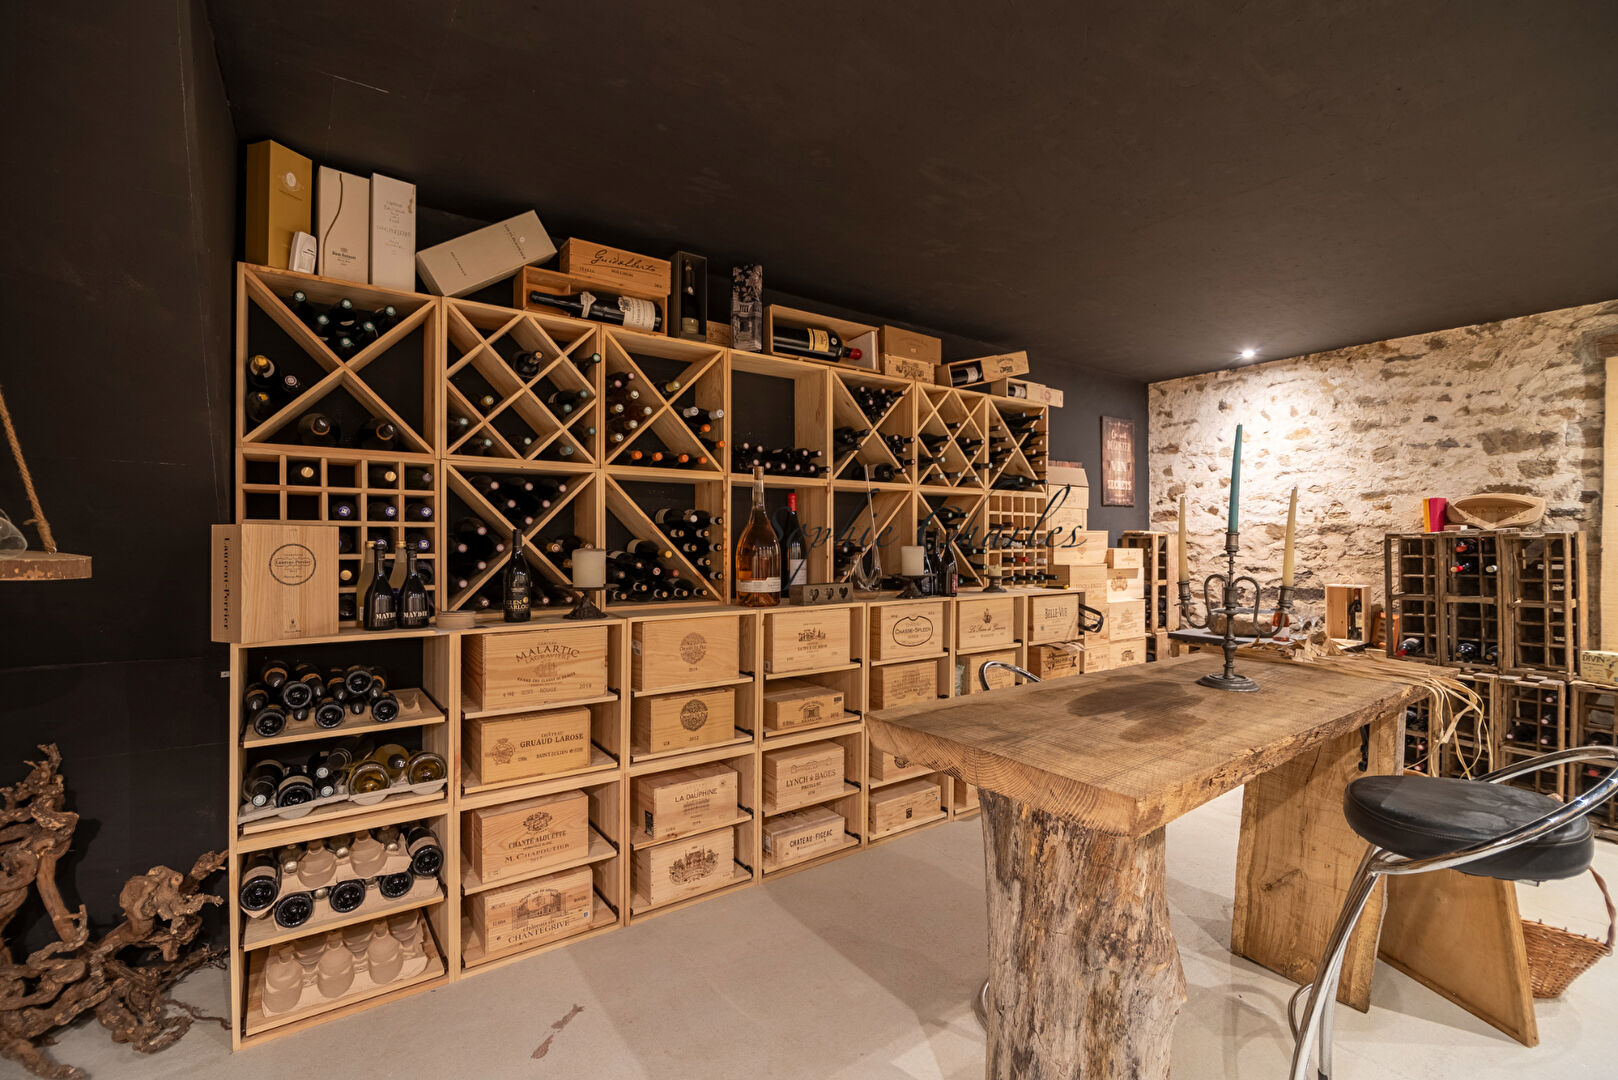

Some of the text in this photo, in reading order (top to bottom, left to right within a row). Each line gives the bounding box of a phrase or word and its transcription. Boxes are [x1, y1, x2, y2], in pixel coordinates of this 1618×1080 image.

[516, 644, 580, 663] MALARTIC
[1582, 654, 1606, 663] DIVIN
[519, 733, 584, 748] GRUAUD LAROSE
[785, 769, 836, 788] LYNCH BAGES
[686, 788, 718, 800] DAUPHINE
[508, 837, 534, 849] CHANTE
[535, 830, 567, 843] ALOUETTE
[789, 829, 833, 848] CHATEAU FIGEAC
[516, 843, 570, 860] CHAPOUTIER
[508, 920, 570, 943] CHANTEGRIVE
